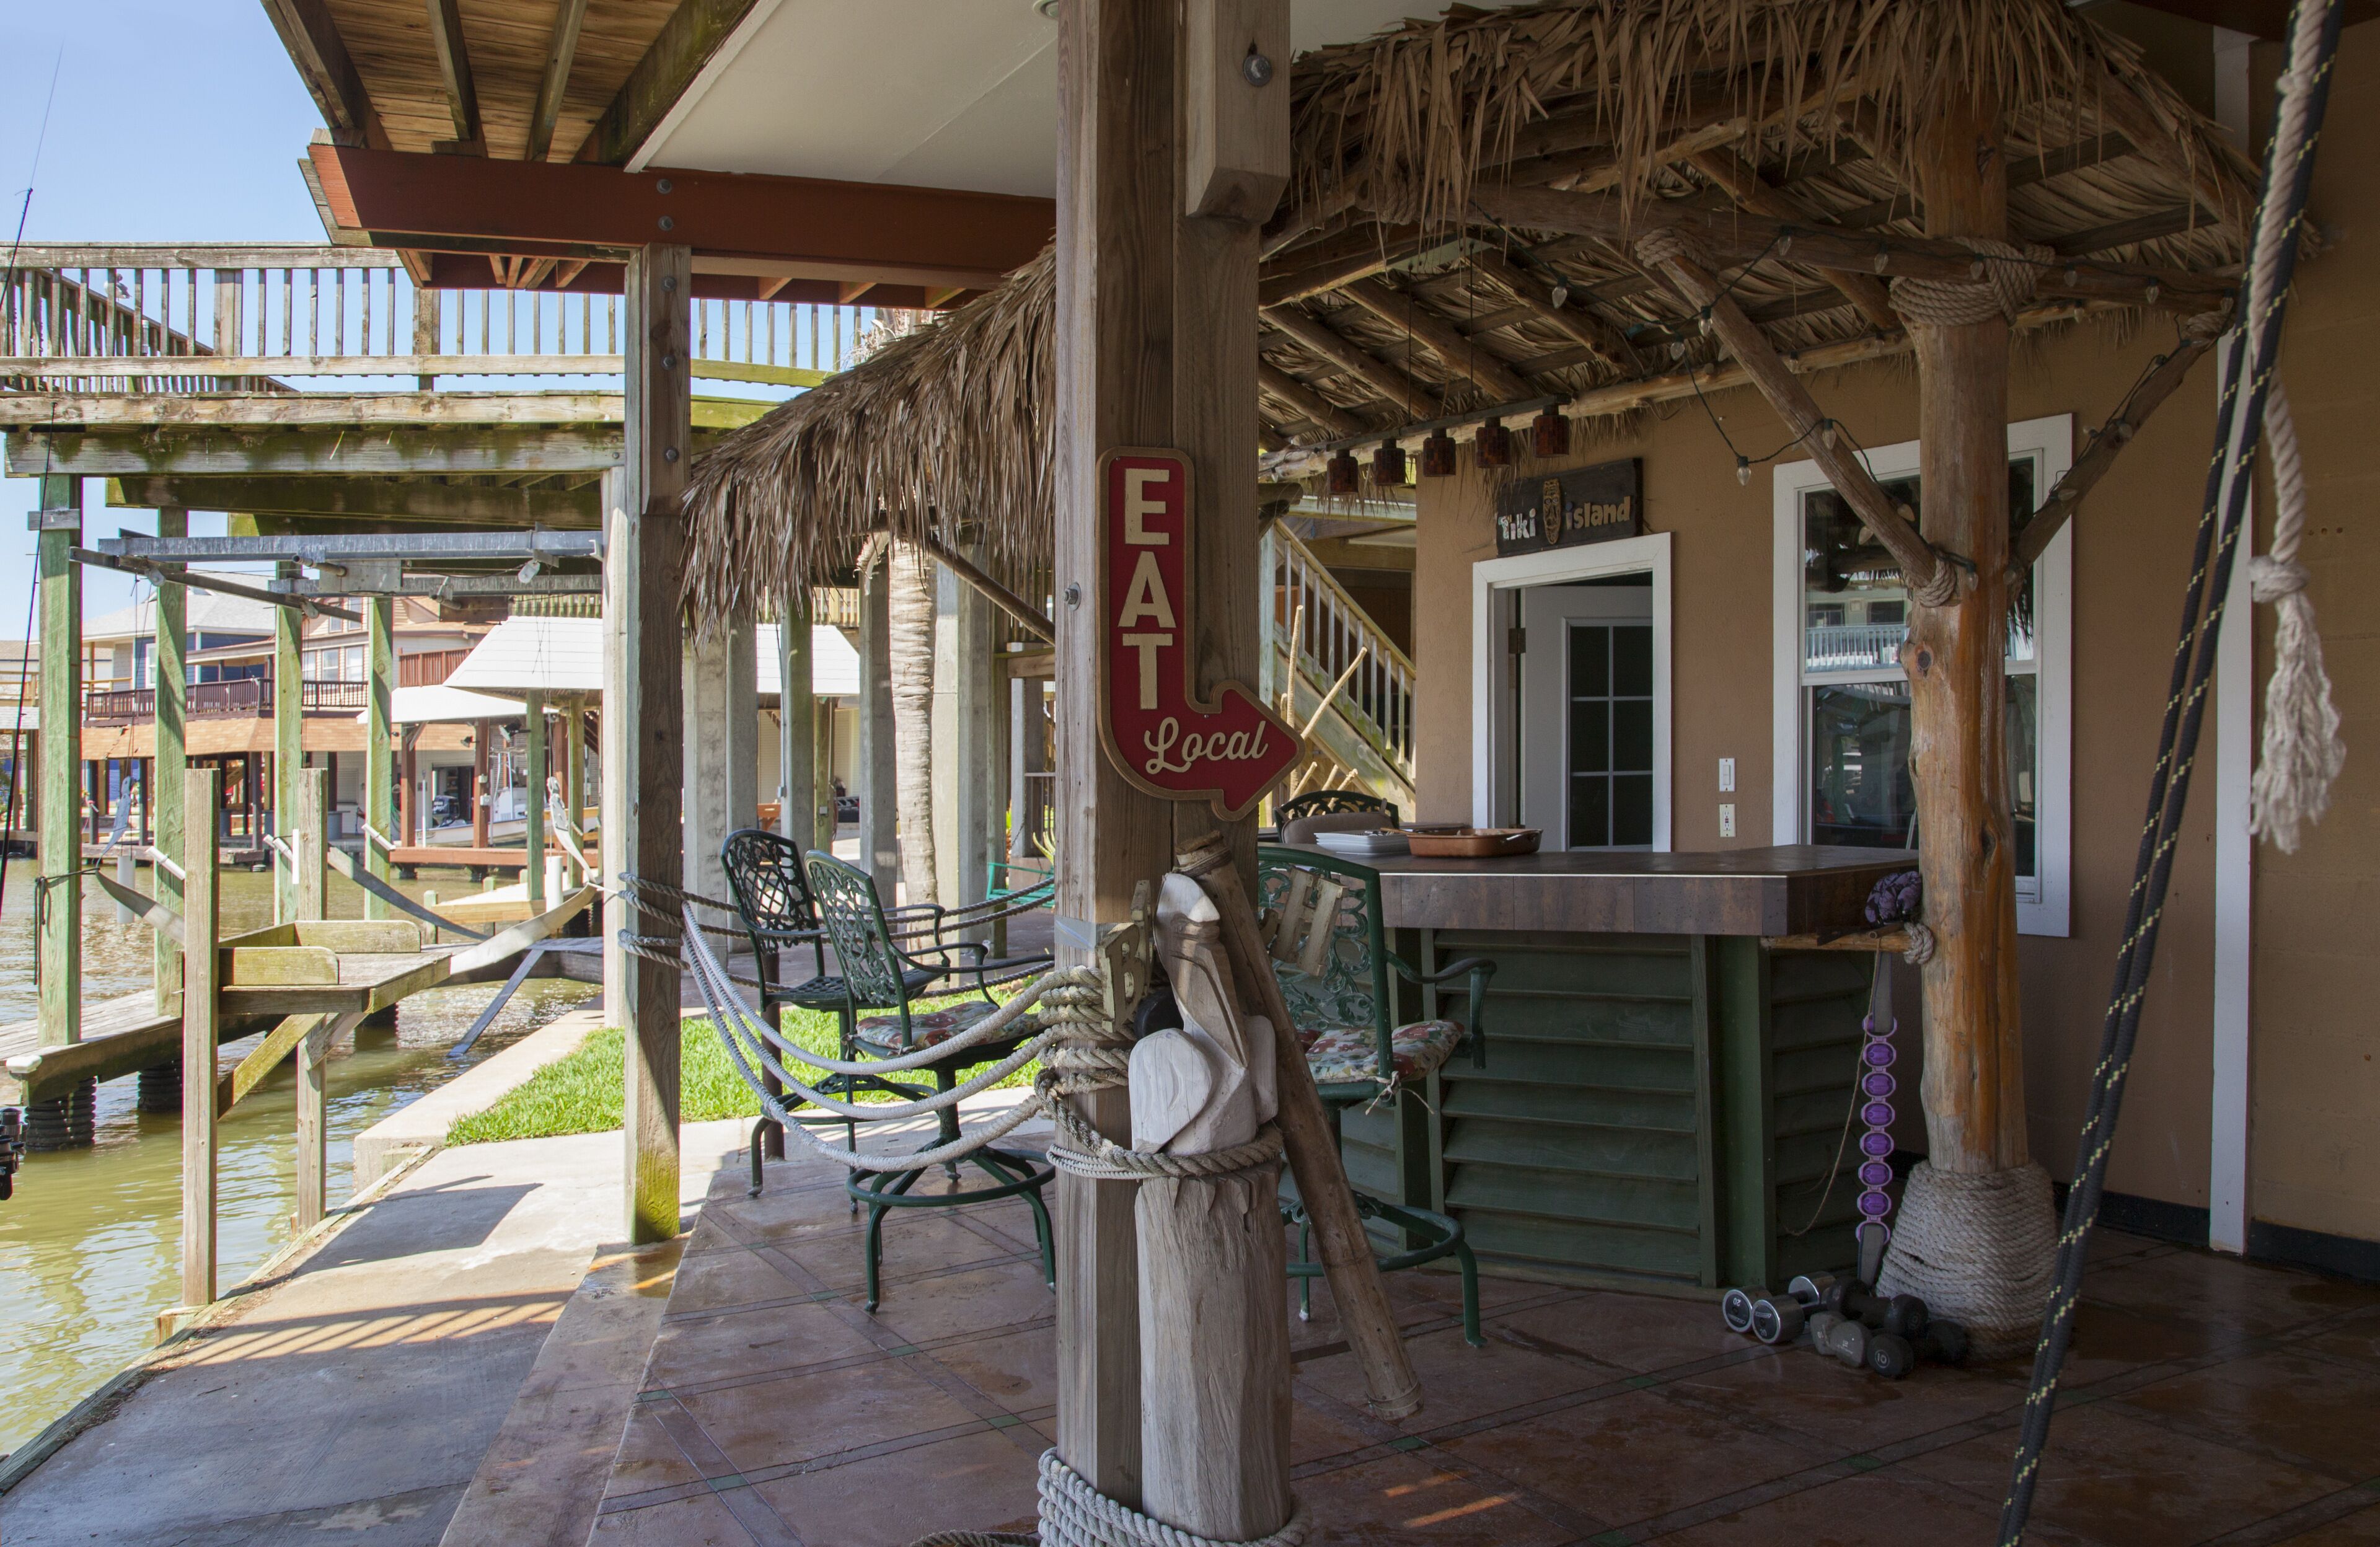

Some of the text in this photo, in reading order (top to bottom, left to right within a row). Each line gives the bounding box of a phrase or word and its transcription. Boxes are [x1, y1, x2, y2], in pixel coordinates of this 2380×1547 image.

[1498, 496, 1631, 541] Tiki island
[1117, 468, 1176, 710] EAT
[1144, 716, 1269, 775] Local
[1733, 1297, 1741, 1307] 20
[1877, 1352, 1887, 1364] 10
